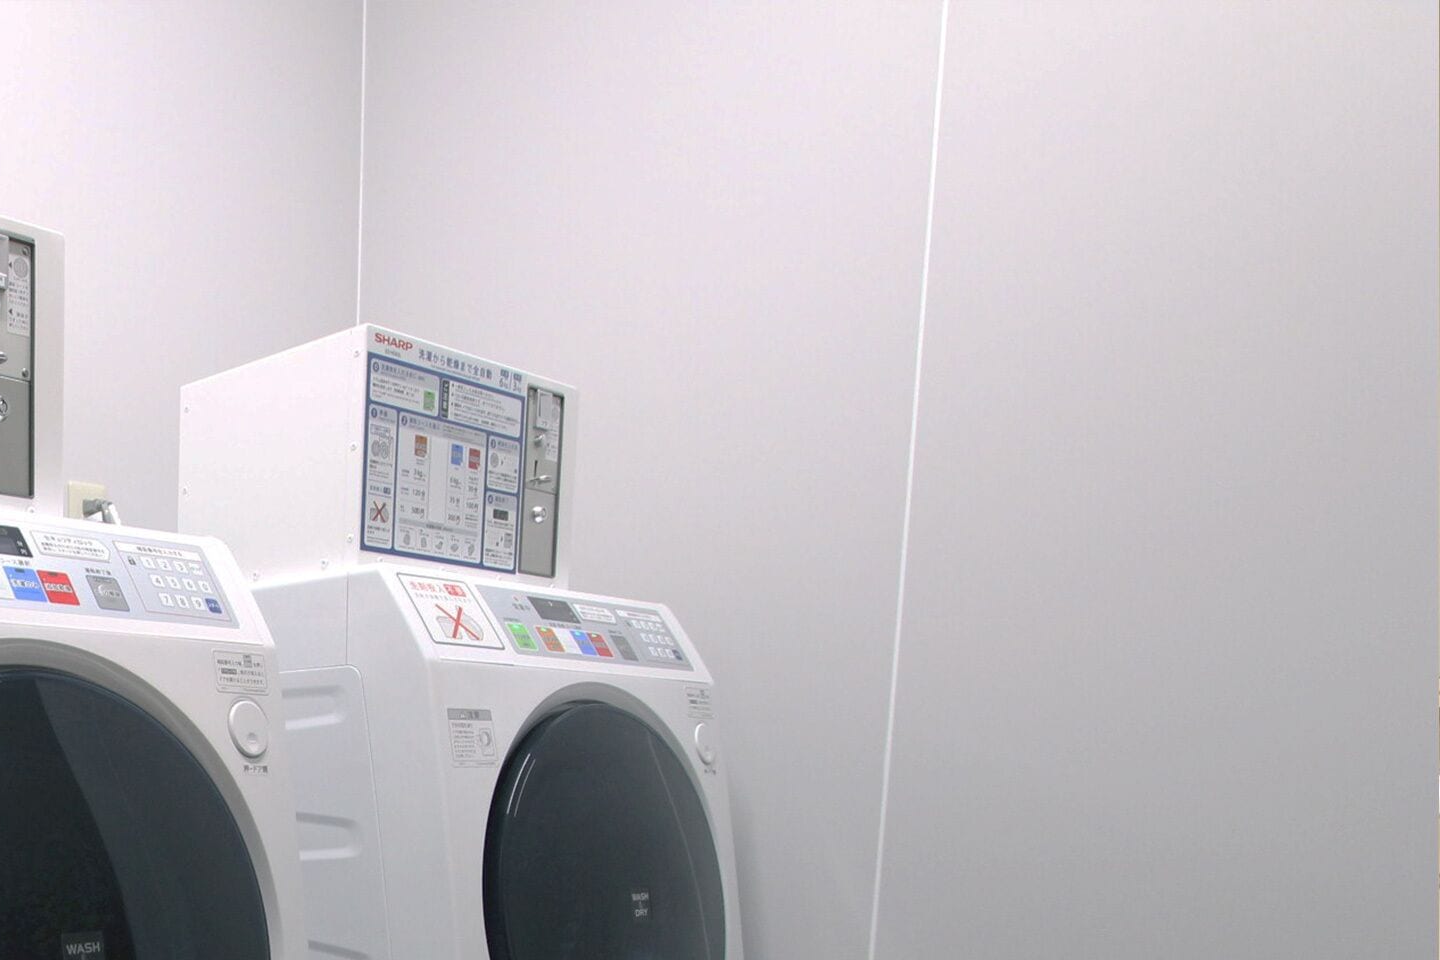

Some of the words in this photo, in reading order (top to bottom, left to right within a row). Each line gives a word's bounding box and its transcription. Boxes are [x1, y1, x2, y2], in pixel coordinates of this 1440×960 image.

[374, 332, 413, 351] SHARP
[418, 349, 493, 380] 洗濯から乾燥まで全自動
[66, 941, 101, 955] WASH
